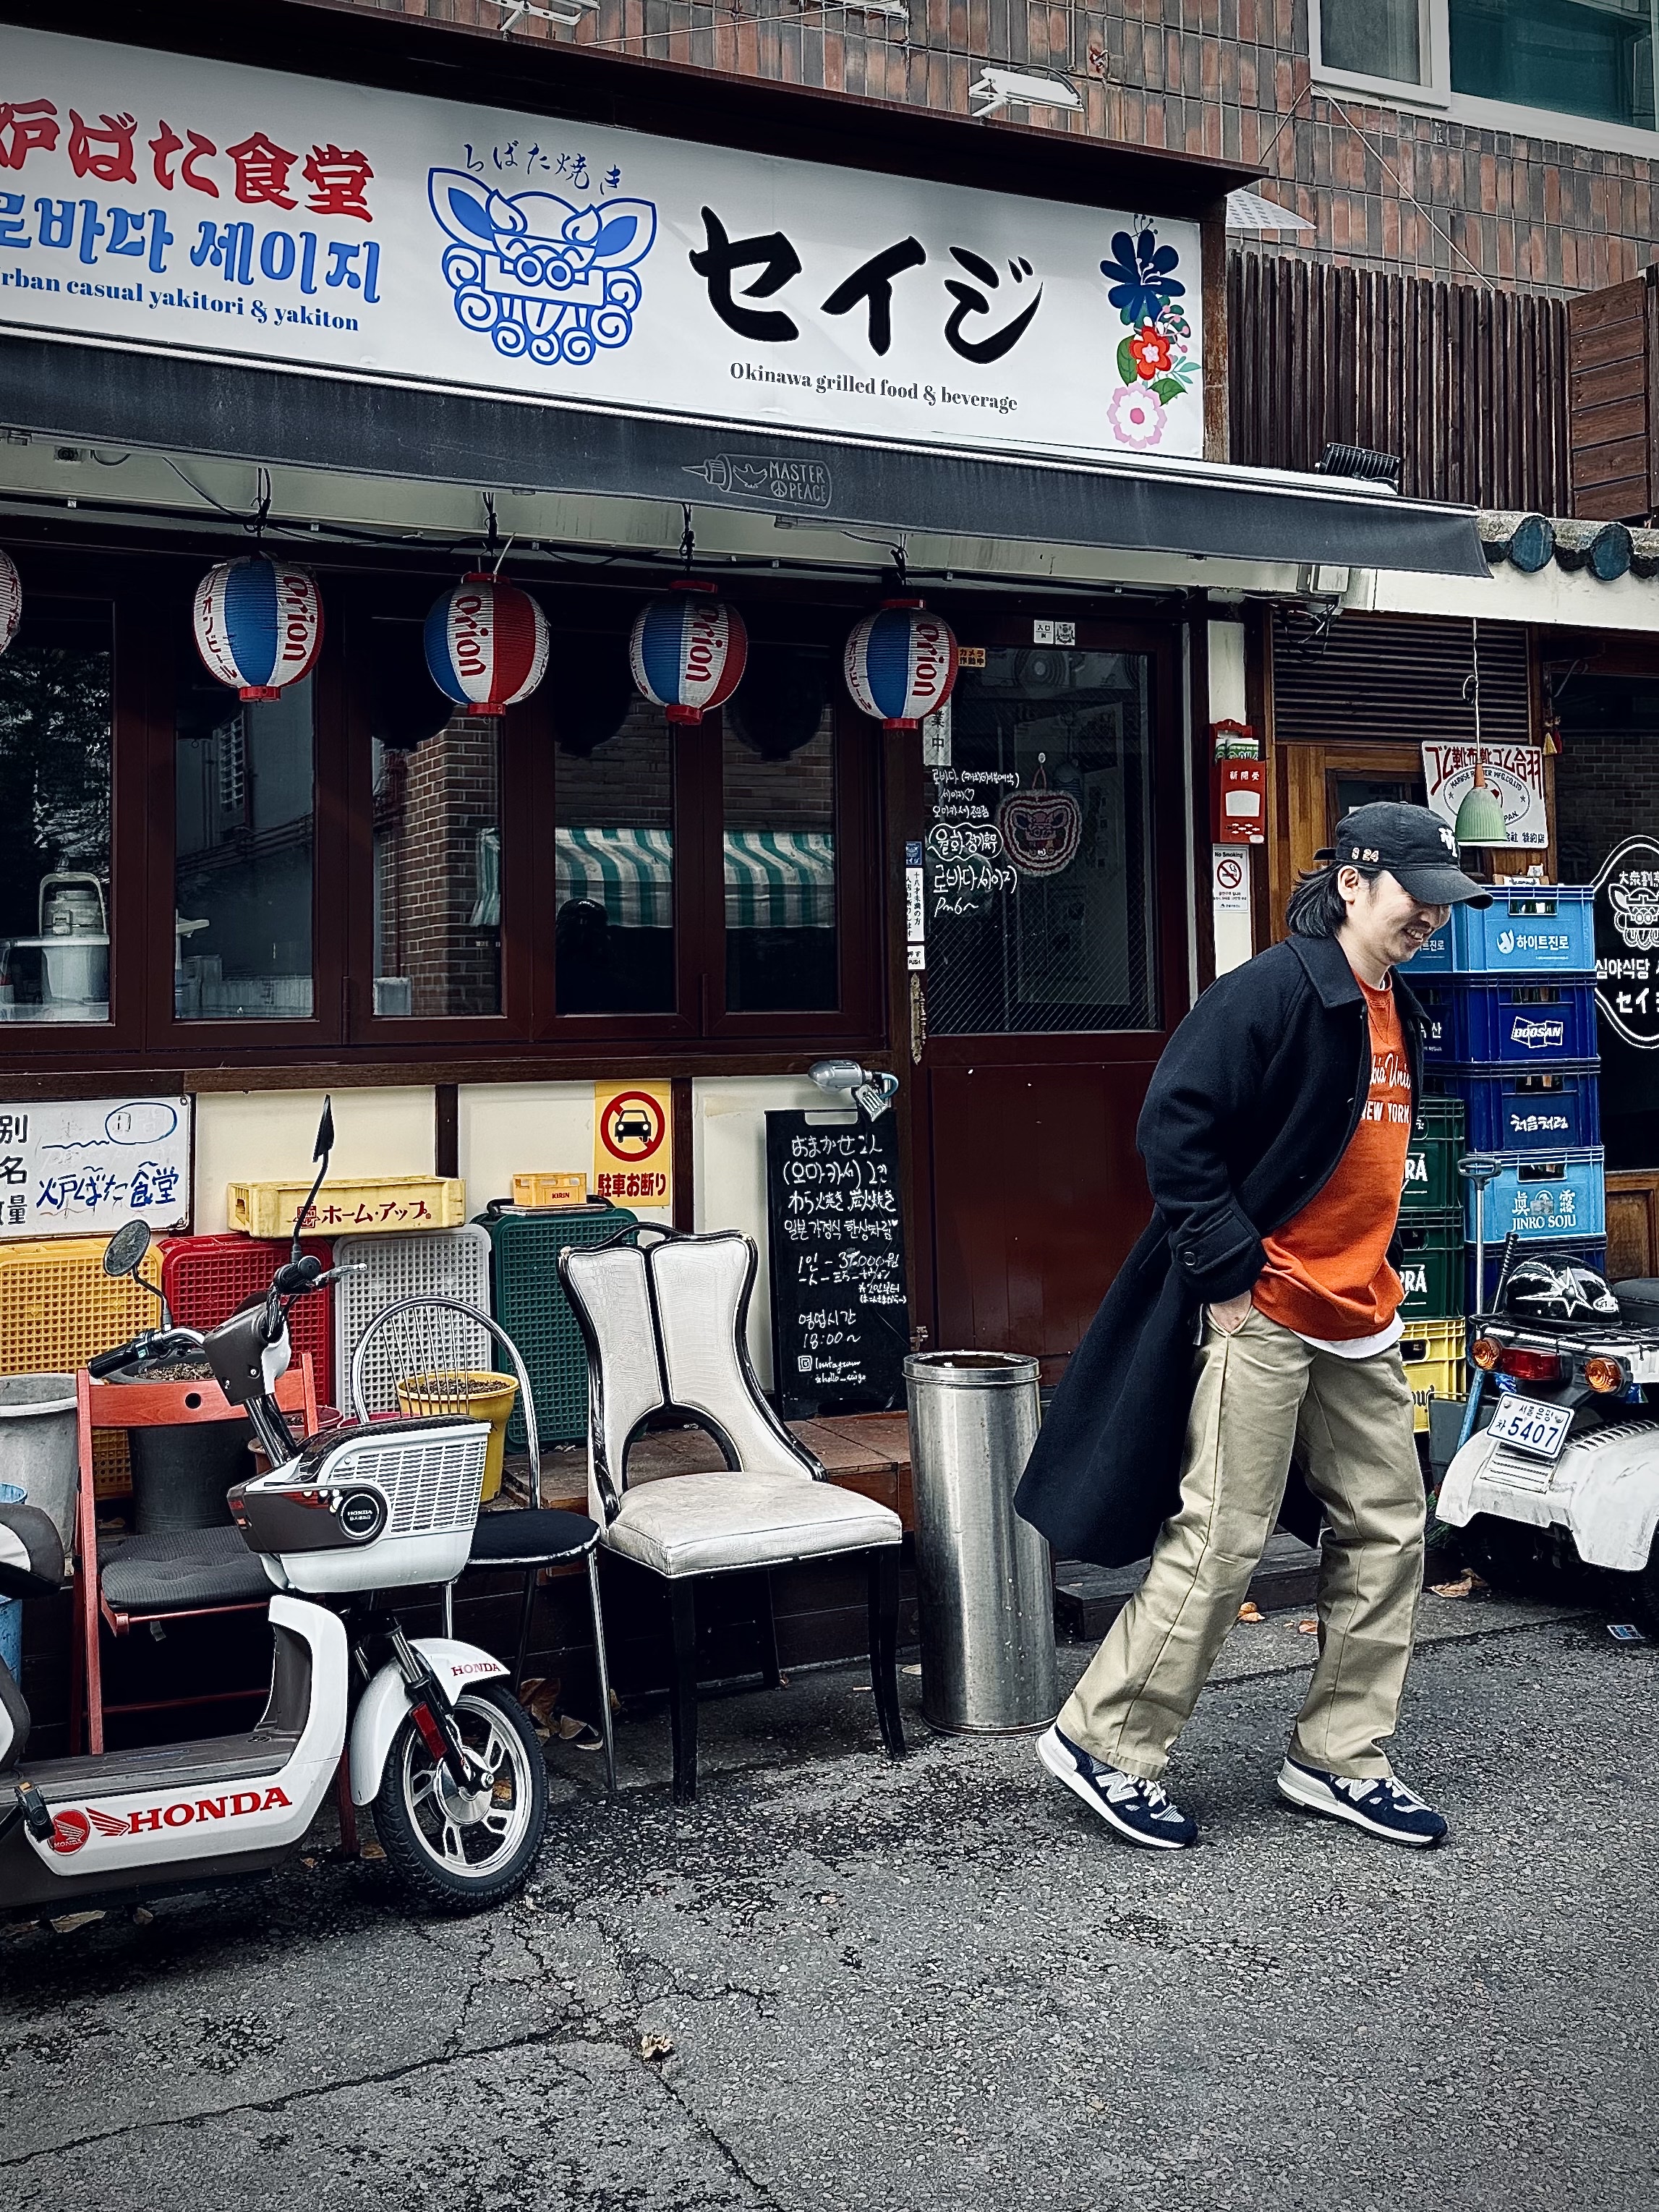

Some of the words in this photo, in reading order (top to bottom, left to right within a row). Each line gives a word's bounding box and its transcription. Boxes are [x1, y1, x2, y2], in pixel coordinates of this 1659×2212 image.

[190, 221, 380, 303] 세이지
[688, 205, 1044, 364] セイジ
[0, 267, 60, 292] rban
[67, 278, 142, 302] casual
[149, 289, 244, 315] yakitori
[251, 300, 268, 323] &
[274, 306, 359, 331] yakiton
[730, 362, 812, 388] Okinawa
[816, 375, 876, 395] grilled
[880, 380, 918, 400] food
[924, 386, 937, 407] &
[942, 386, 1018, 414] beverage
[769, 461, 825, 484] MASTER
[790, 482, 826, 503] PEACE
[931, 710, 944, 752] 業中
[1362, 848, 1379, 862] 24
[1516, 935, 1569, 952] 하이트진로
[1594, 958, 1650, 979] 심야식당
[1514, 1026, 1562, 1038] DOOSAN
[1361, 1101, 1384, 1121] NEW
[1387, 1102, 1410, 1124] YORK
[598, 1173, 667, 1198] 駐車お断り
[1548, 1215, 1577, 1230] SOJU
[1508, 1416, 1559, 1447] 5407
[451, 1662, 502, 1677] HONDA
[127, 1787, 293, 1835] HONDA
[54, 1839, 83, 1849] HONDA
